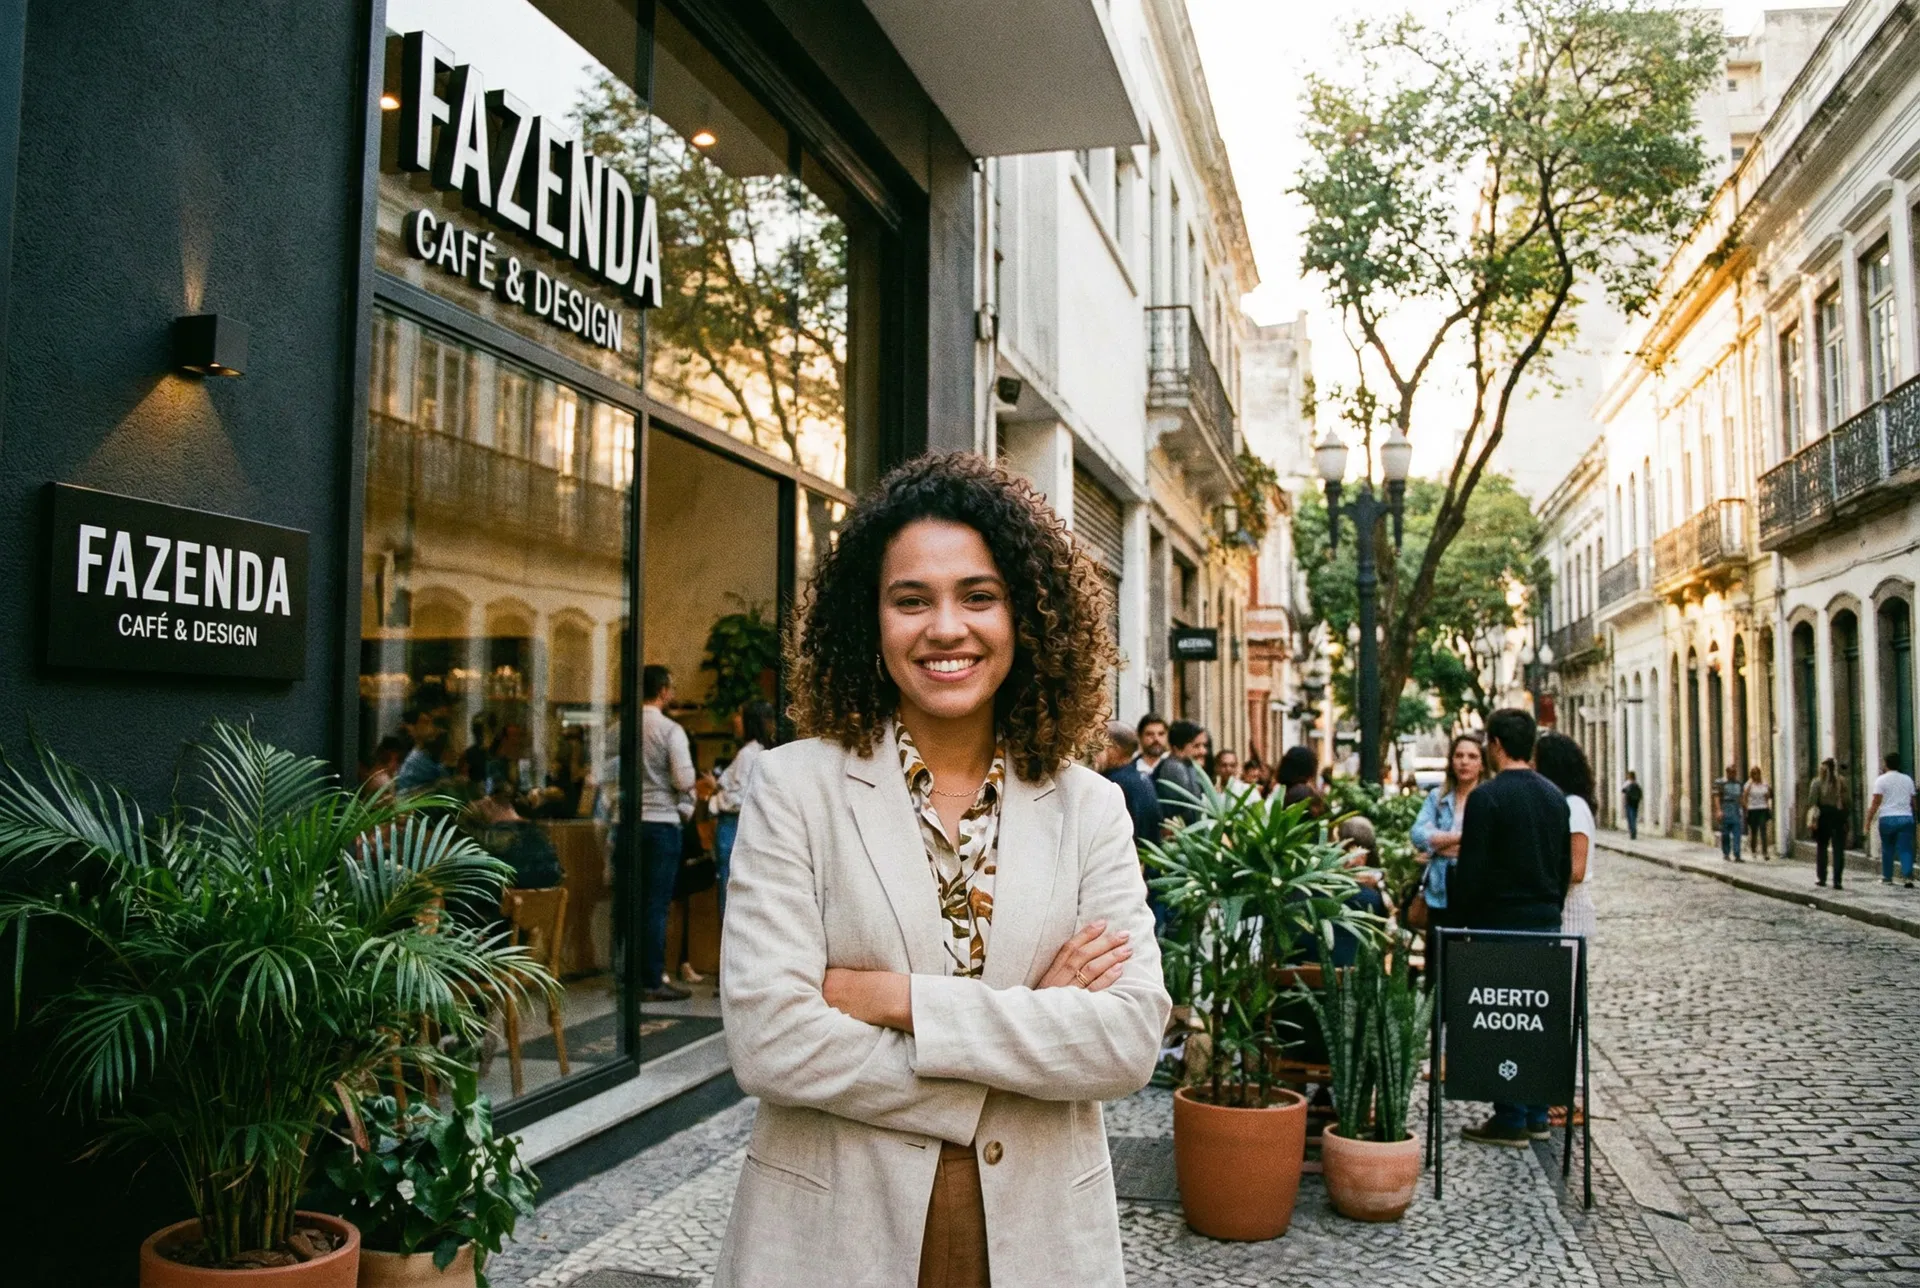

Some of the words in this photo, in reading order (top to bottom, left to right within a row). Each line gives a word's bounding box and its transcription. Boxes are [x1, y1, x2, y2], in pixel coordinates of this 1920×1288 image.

[414, 30, 663, 308] FAZENDA
[415, 208, 495, 290] CAFÉ
[505, 256, 526, 305] &
[534, 270, 622, 353] DESIGN
[77, 523, 291, 616] FAZENDA
[118, 612, 169, 639] CAFÉ
[174, 619, 188, 641] &
[193, 620, 258, 647] DESIGN
[1468, 987, 1550, 1008] ABERTO
[1472, 1011, 1544, 1031] AGORA
